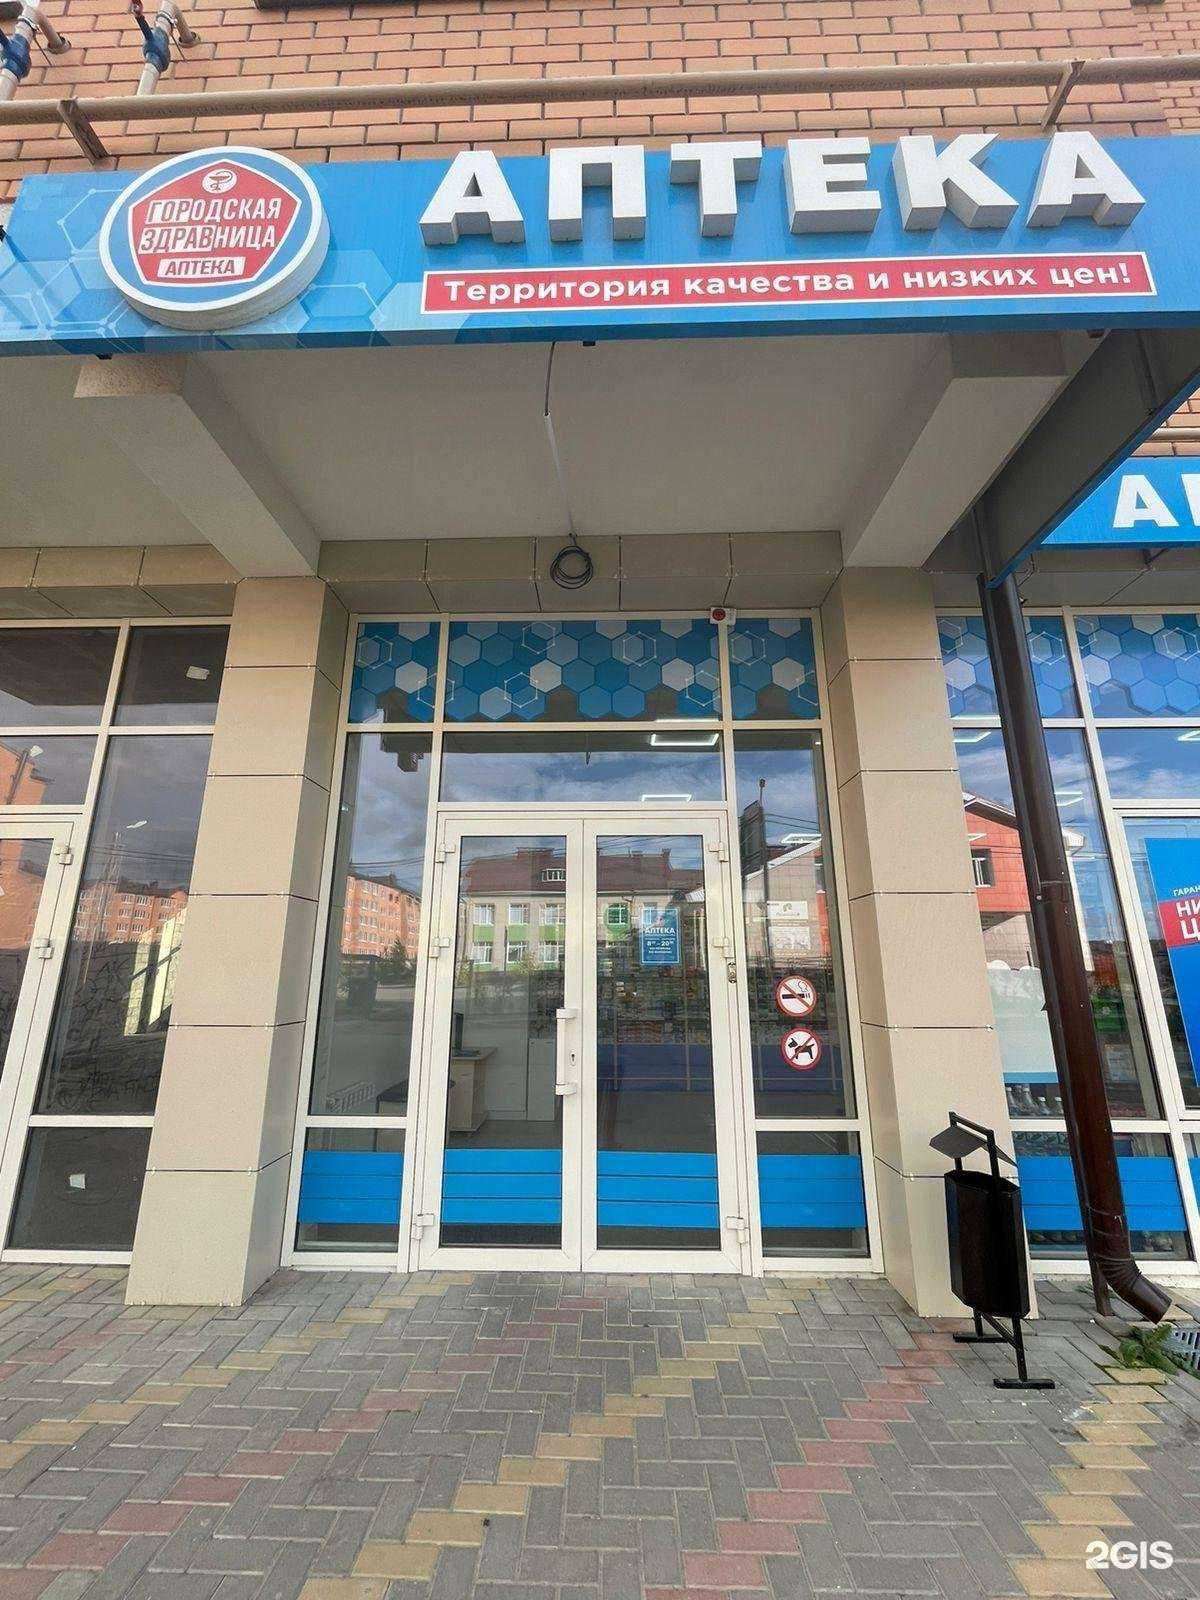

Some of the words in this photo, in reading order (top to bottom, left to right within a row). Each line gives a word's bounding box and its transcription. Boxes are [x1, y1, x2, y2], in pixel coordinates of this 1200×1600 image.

[419, 131, 1146, 247] АПТЕКА
[147, 198, 282, 222] ГОРОДСКАЯ
[140, 225, 277, 252] ЗДРАВНИЦА
[164, 259, 236, 276] АПТЕКА
[443, 278, 670, 304] Территория
[684, 272, 854, 296] качества
[868, 271, 889, 290] и
[903, 267, 1037, 288] низких
[1051, 262, 1131, 289] цен!
